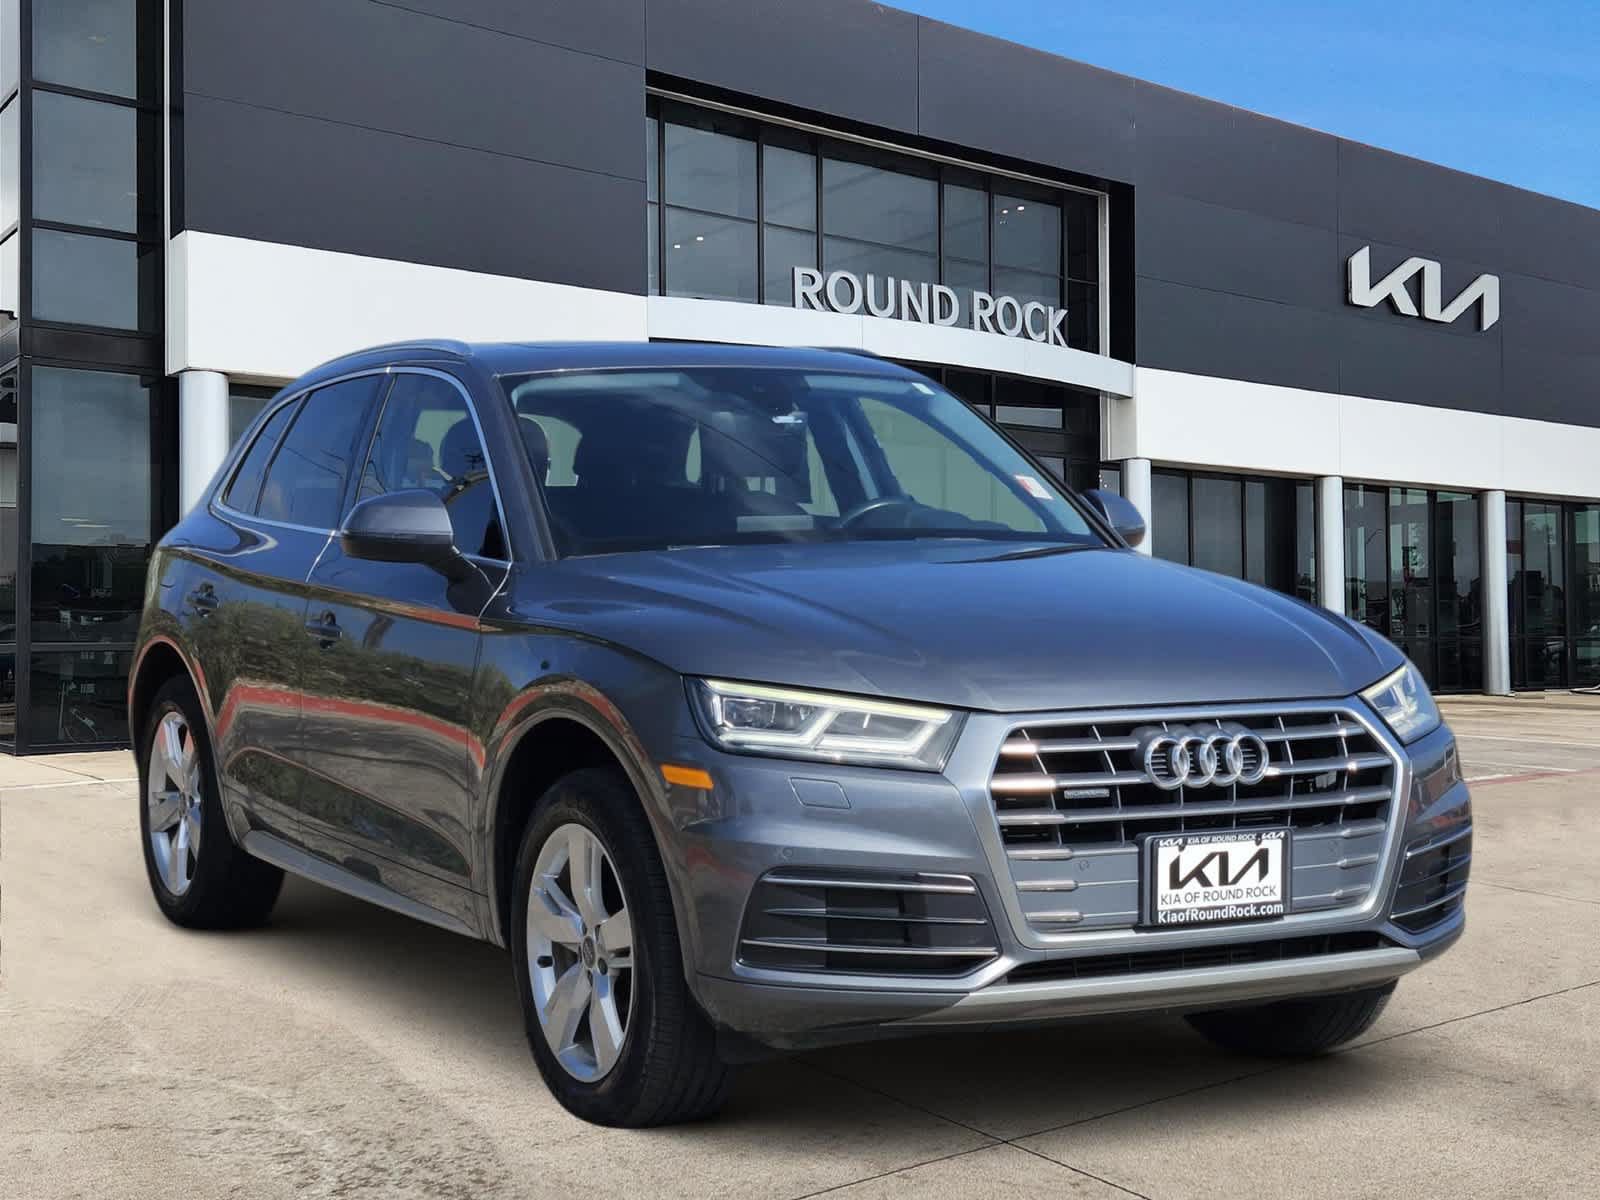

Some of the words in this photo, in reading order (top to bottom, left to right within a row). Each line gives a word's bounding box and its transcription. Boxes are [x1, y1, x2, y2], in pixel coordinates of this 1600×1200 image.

[792, 266, 960, 327] ROUND
[971, 290, 1068, 348] ROCK
[1347, 245, 1499, 331] KIA
[1169, 847, 1269, 890] KIA
[1158, 903, 1284, 923] KiaofRoundRock.com
[1161, 893, 1181, 905] KIA
[1184, 891, 1200, 904] OF
[1203, 888, 1244, 902] ROUND
[1246, 885, 1277, 899] ROCK
